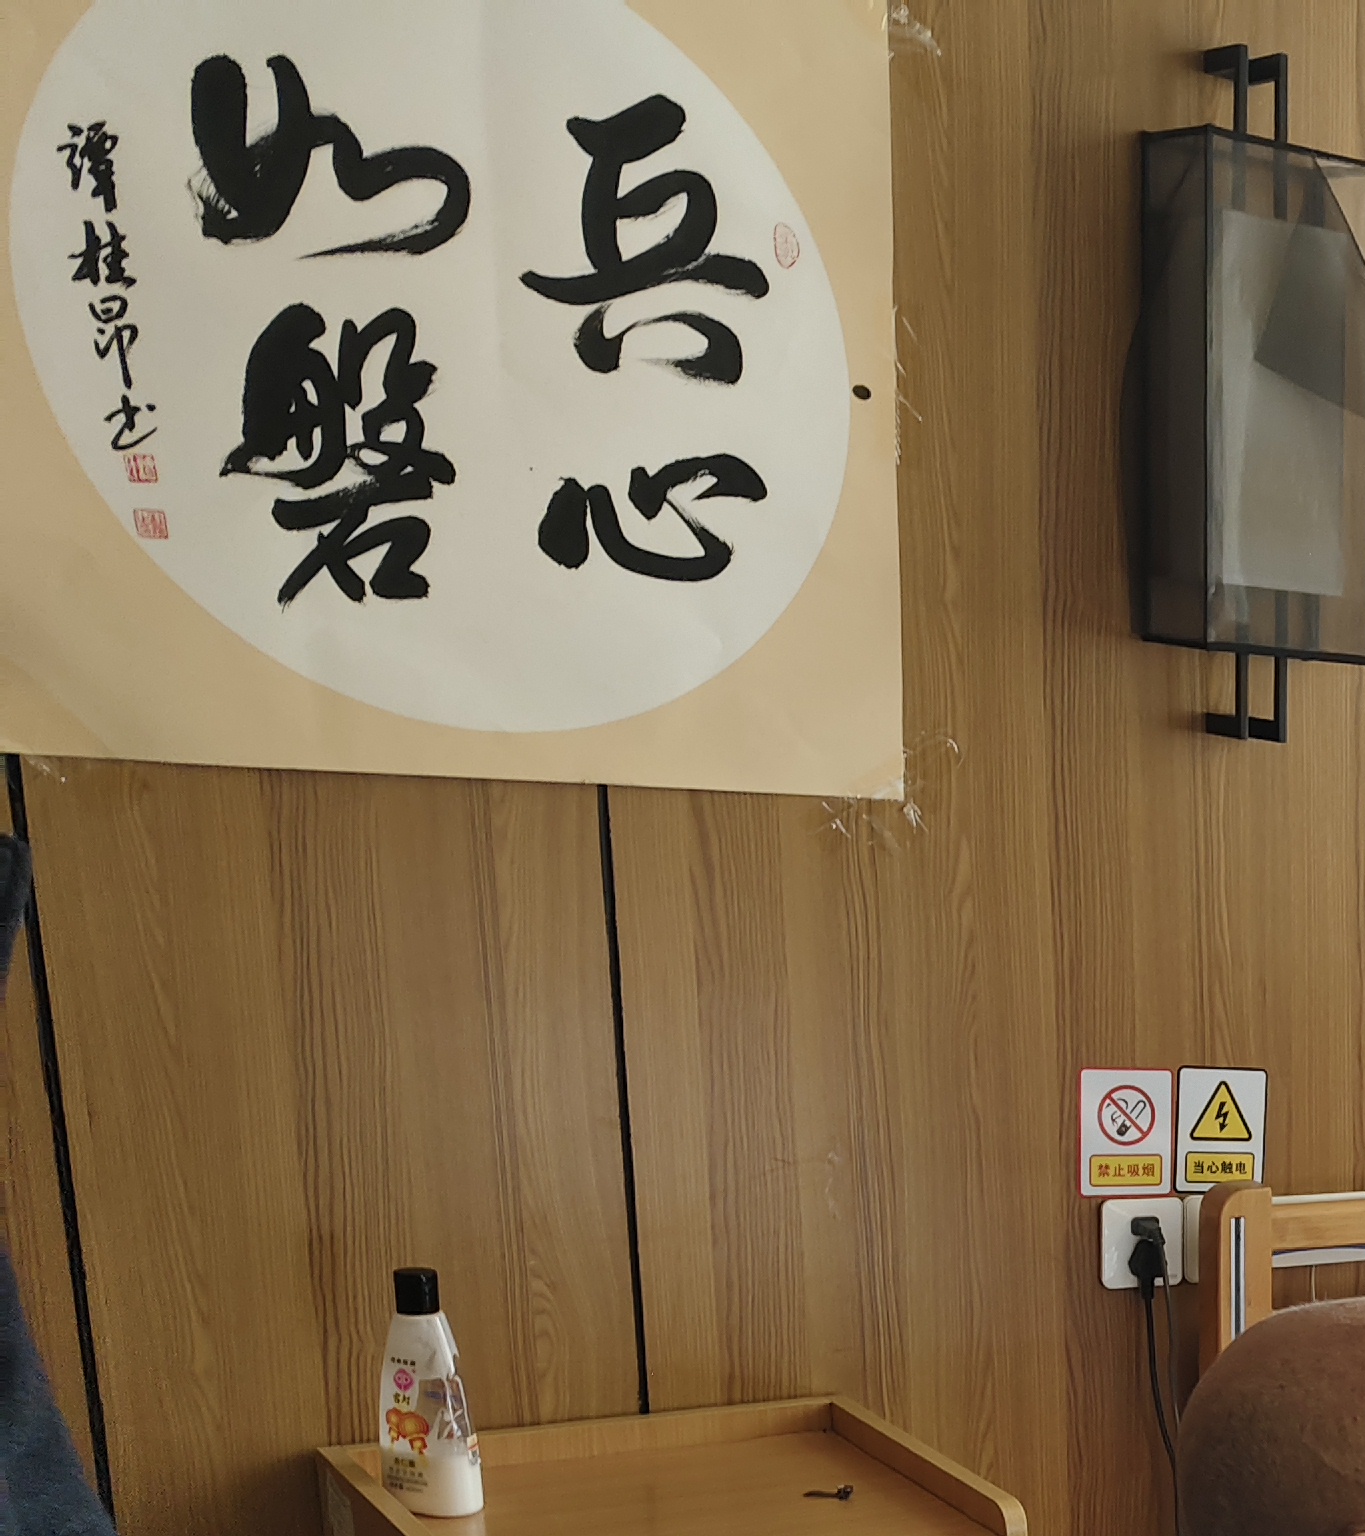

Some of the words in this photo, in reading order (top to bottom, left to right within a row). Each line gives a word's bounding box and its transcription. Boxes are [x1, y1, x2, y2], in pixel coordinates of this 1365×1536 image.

[518, 94, 770, 582] 兵心
[1097, 1162, 1156, 1178] 禁止吸烟
[1193, 1160, 1248, 1175] 当心触电
